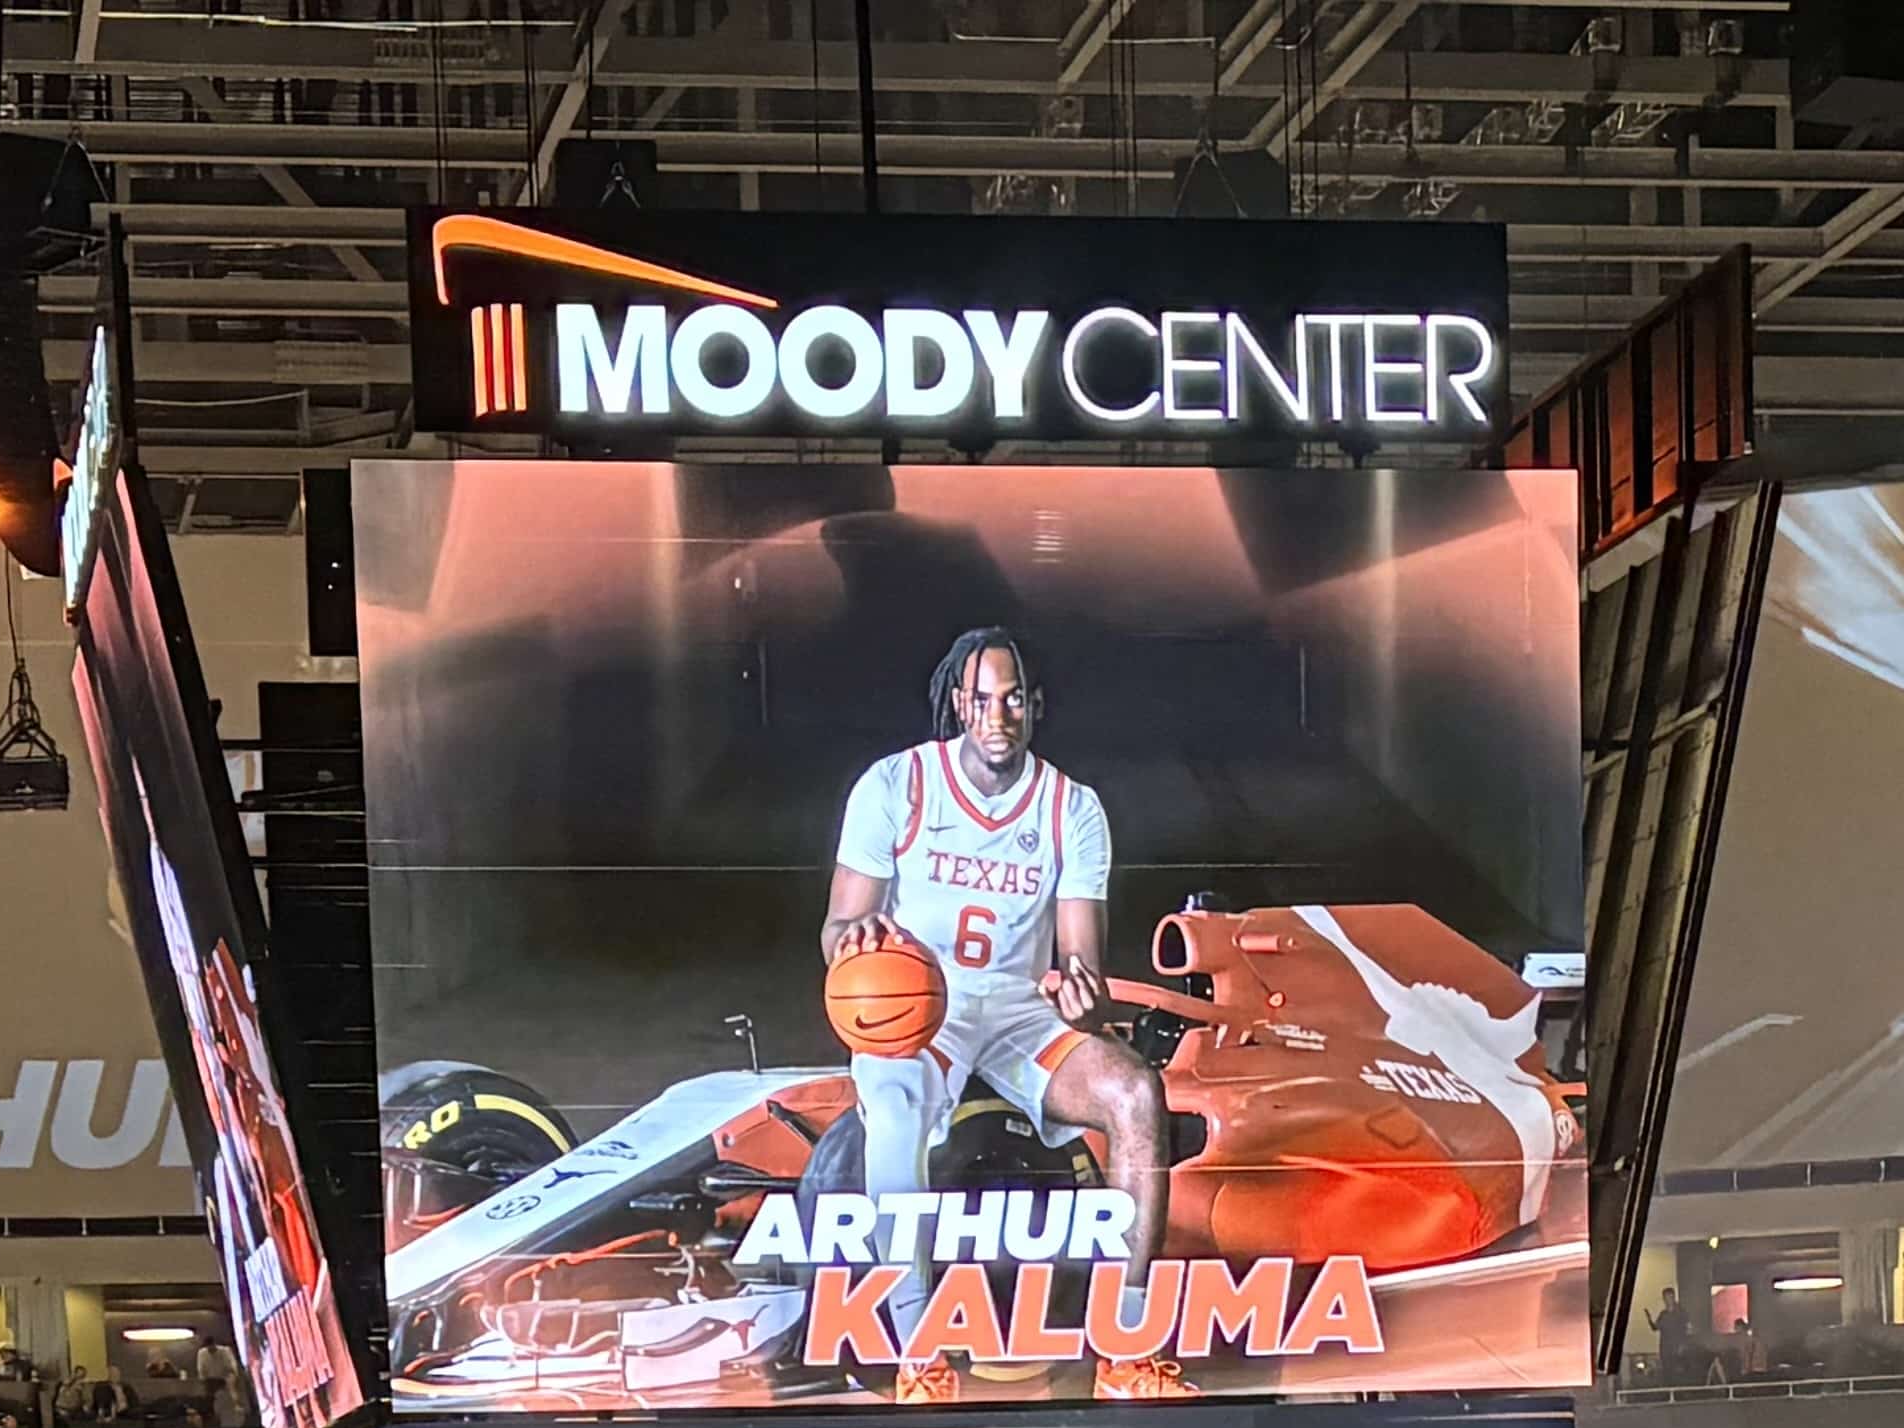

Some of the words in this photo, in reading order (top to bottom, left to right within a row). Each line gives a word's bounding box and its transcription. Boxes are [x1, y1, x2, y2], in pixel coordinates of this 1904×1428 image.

[556, 303, 1049, 419] MOODY
[1062, 306, 1493, 422] CENTER
[927, 850, 1043, 896] TEXAS
[953, 905, 997, 969] 6
[1375, 1059, 1482, 1104] TEXAS
[733, 1188, 1137, 1265] ARTHUR
[802, 1255, 1385, 1366] KALUMA
